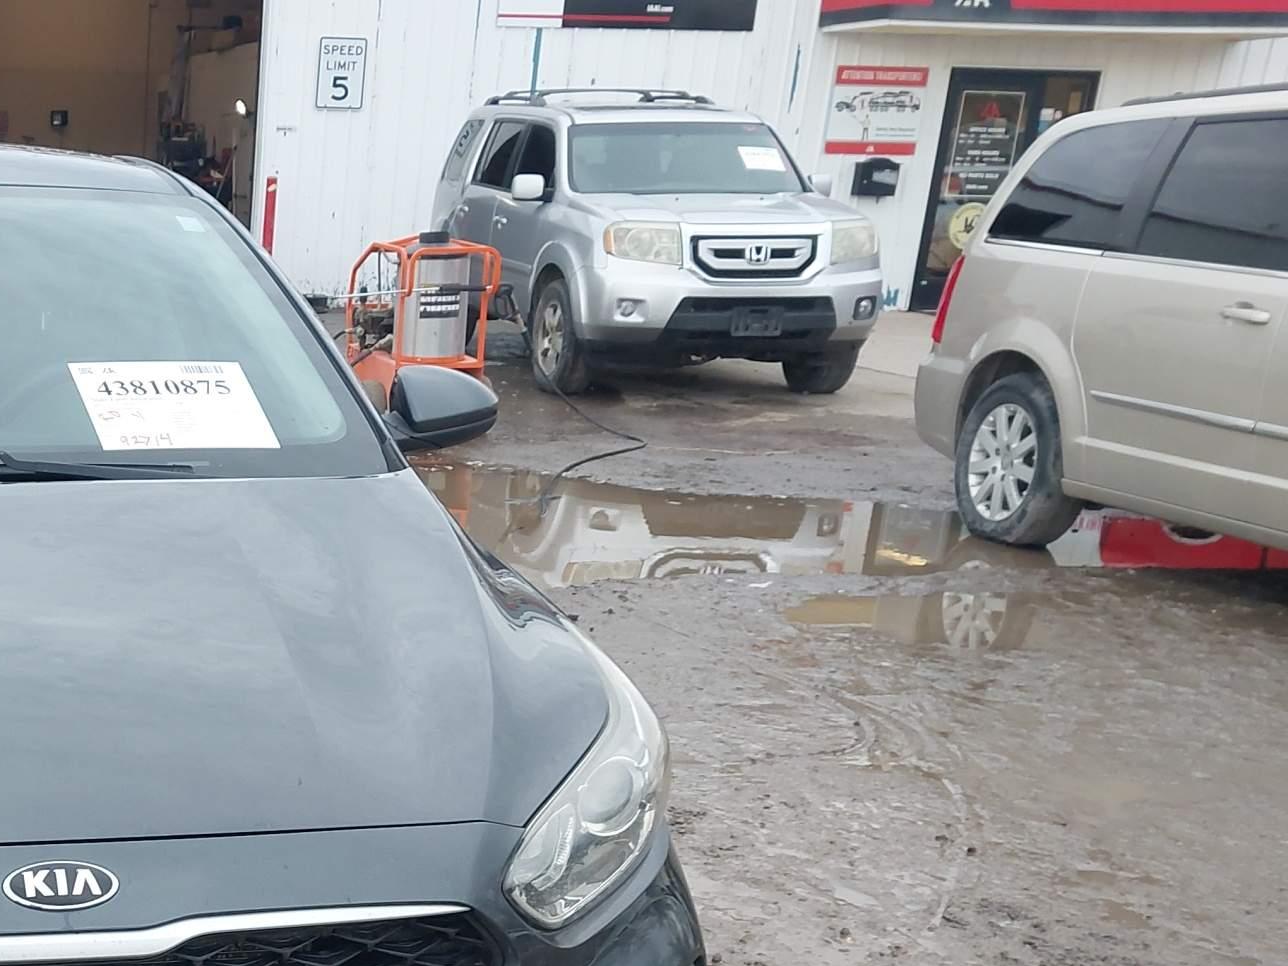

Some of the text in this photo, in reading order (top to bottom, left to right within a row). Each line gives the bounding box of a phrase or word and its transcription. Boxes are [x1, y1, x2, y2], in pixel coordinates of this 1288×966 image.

[323, 44, 363, 56] SPEED
[326, 60, 358, 71] LIMIT
[331, 76, 349, 101] 5
[97, 380, 231, 396] 43810875
[21, 868, 103, 898] KIA
